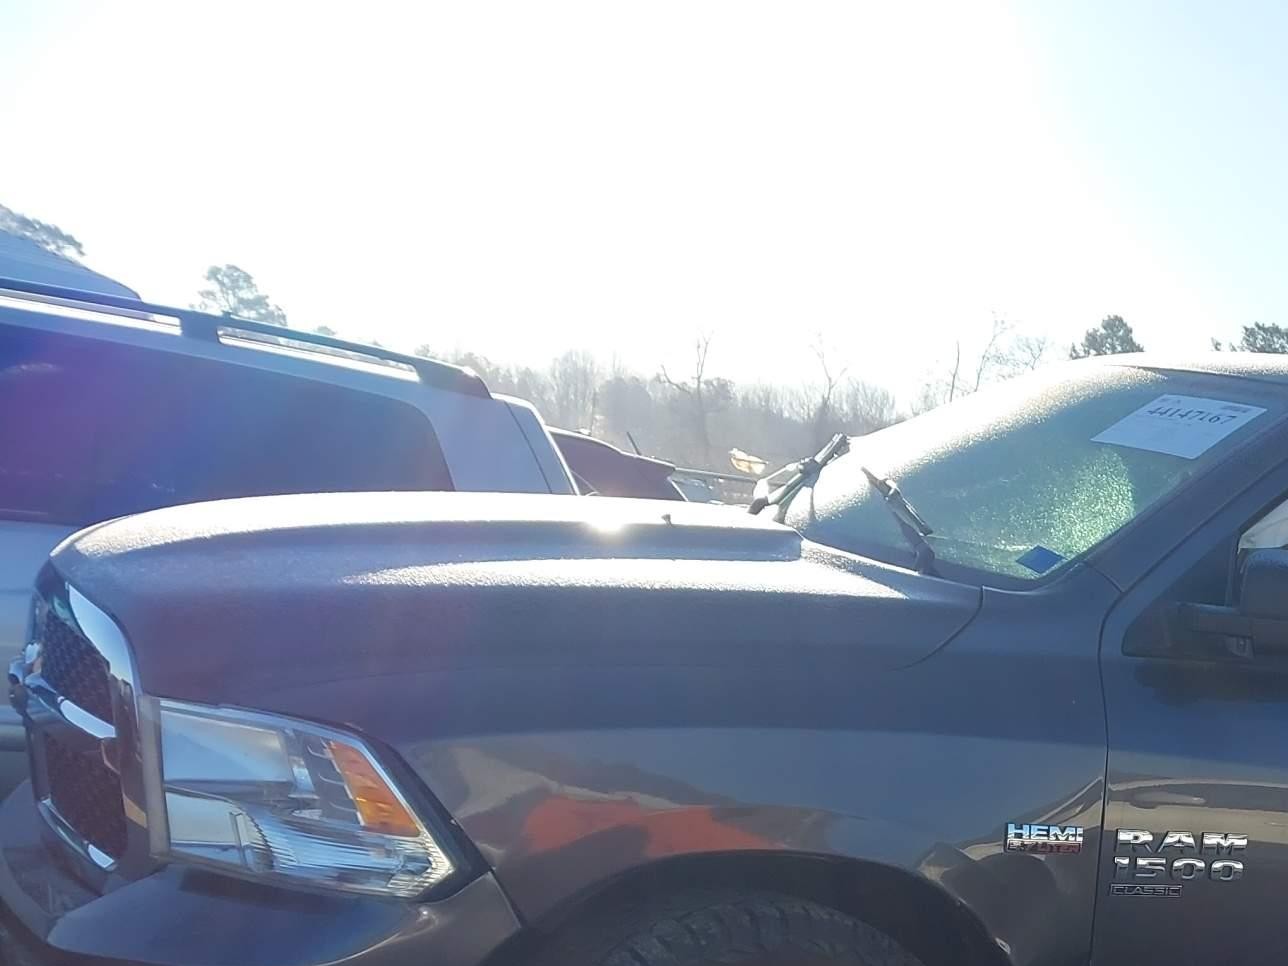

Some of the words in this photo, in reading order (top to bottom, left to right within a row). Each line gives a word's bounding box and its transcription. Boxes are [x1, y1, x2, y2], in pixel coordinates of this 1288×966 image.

[1147, 406, 1238, 425] 44147167
[1006, 823, 1084, 842] HEMI
[1117, 829, 1249, 854] RAM
[1114, 857, 1245, 881] 1500
[1112, 885, 1181, 896] CLASSIC
